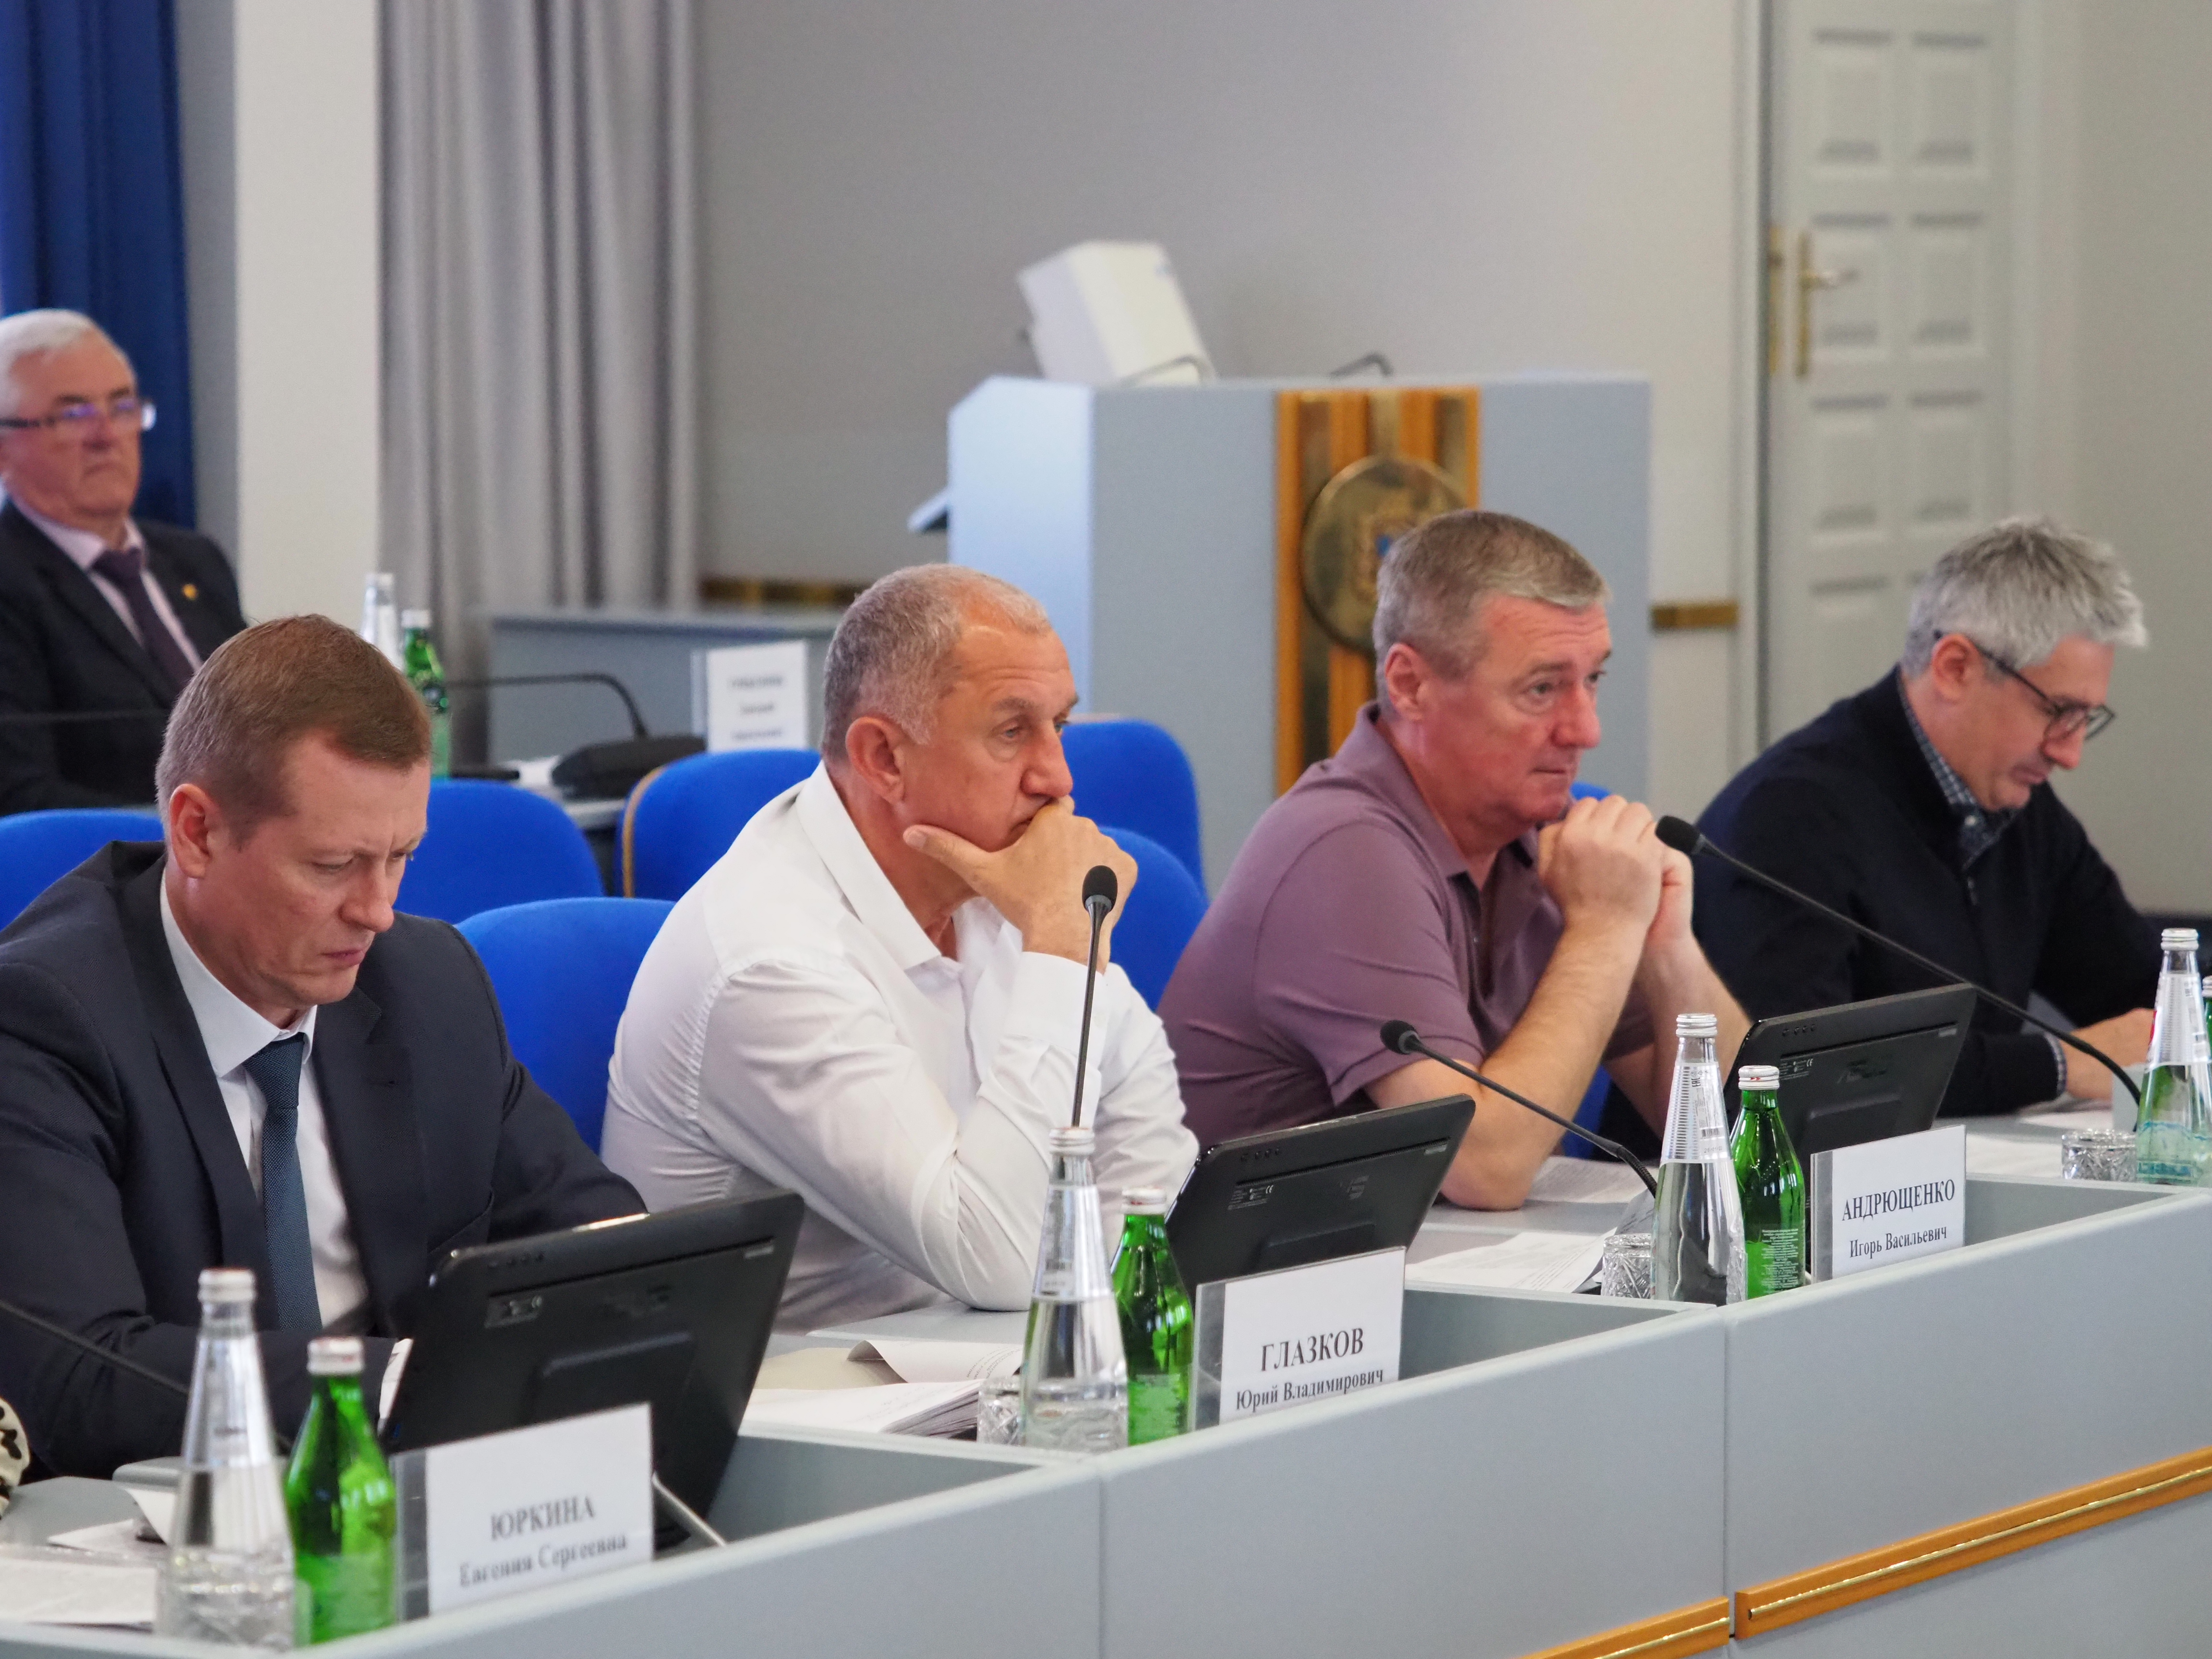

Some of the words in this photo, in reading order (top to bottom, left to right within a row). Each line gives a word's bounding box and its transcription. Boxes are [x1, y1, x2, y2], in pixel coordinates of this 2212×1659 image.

[1842, 1179, 1955, 1222] АНДРЮЩЕНКО
[1850, 1239, 1882, 1259] Игорь
[1885, 1226, 1947, 1250] Васильевич
[1261, 1328, 1363, 1371] ГЛАЗКОВ
[1236, 1384, 1278, 1413] Юрий
[1284, 1369, 1383, 1401] Владимирович
[490, 1495, 595, 1540] ЮРКИНА
[459, 1554, 533, 1587] Евгения
[538, 1534, 627, 1570] Сергеевна
